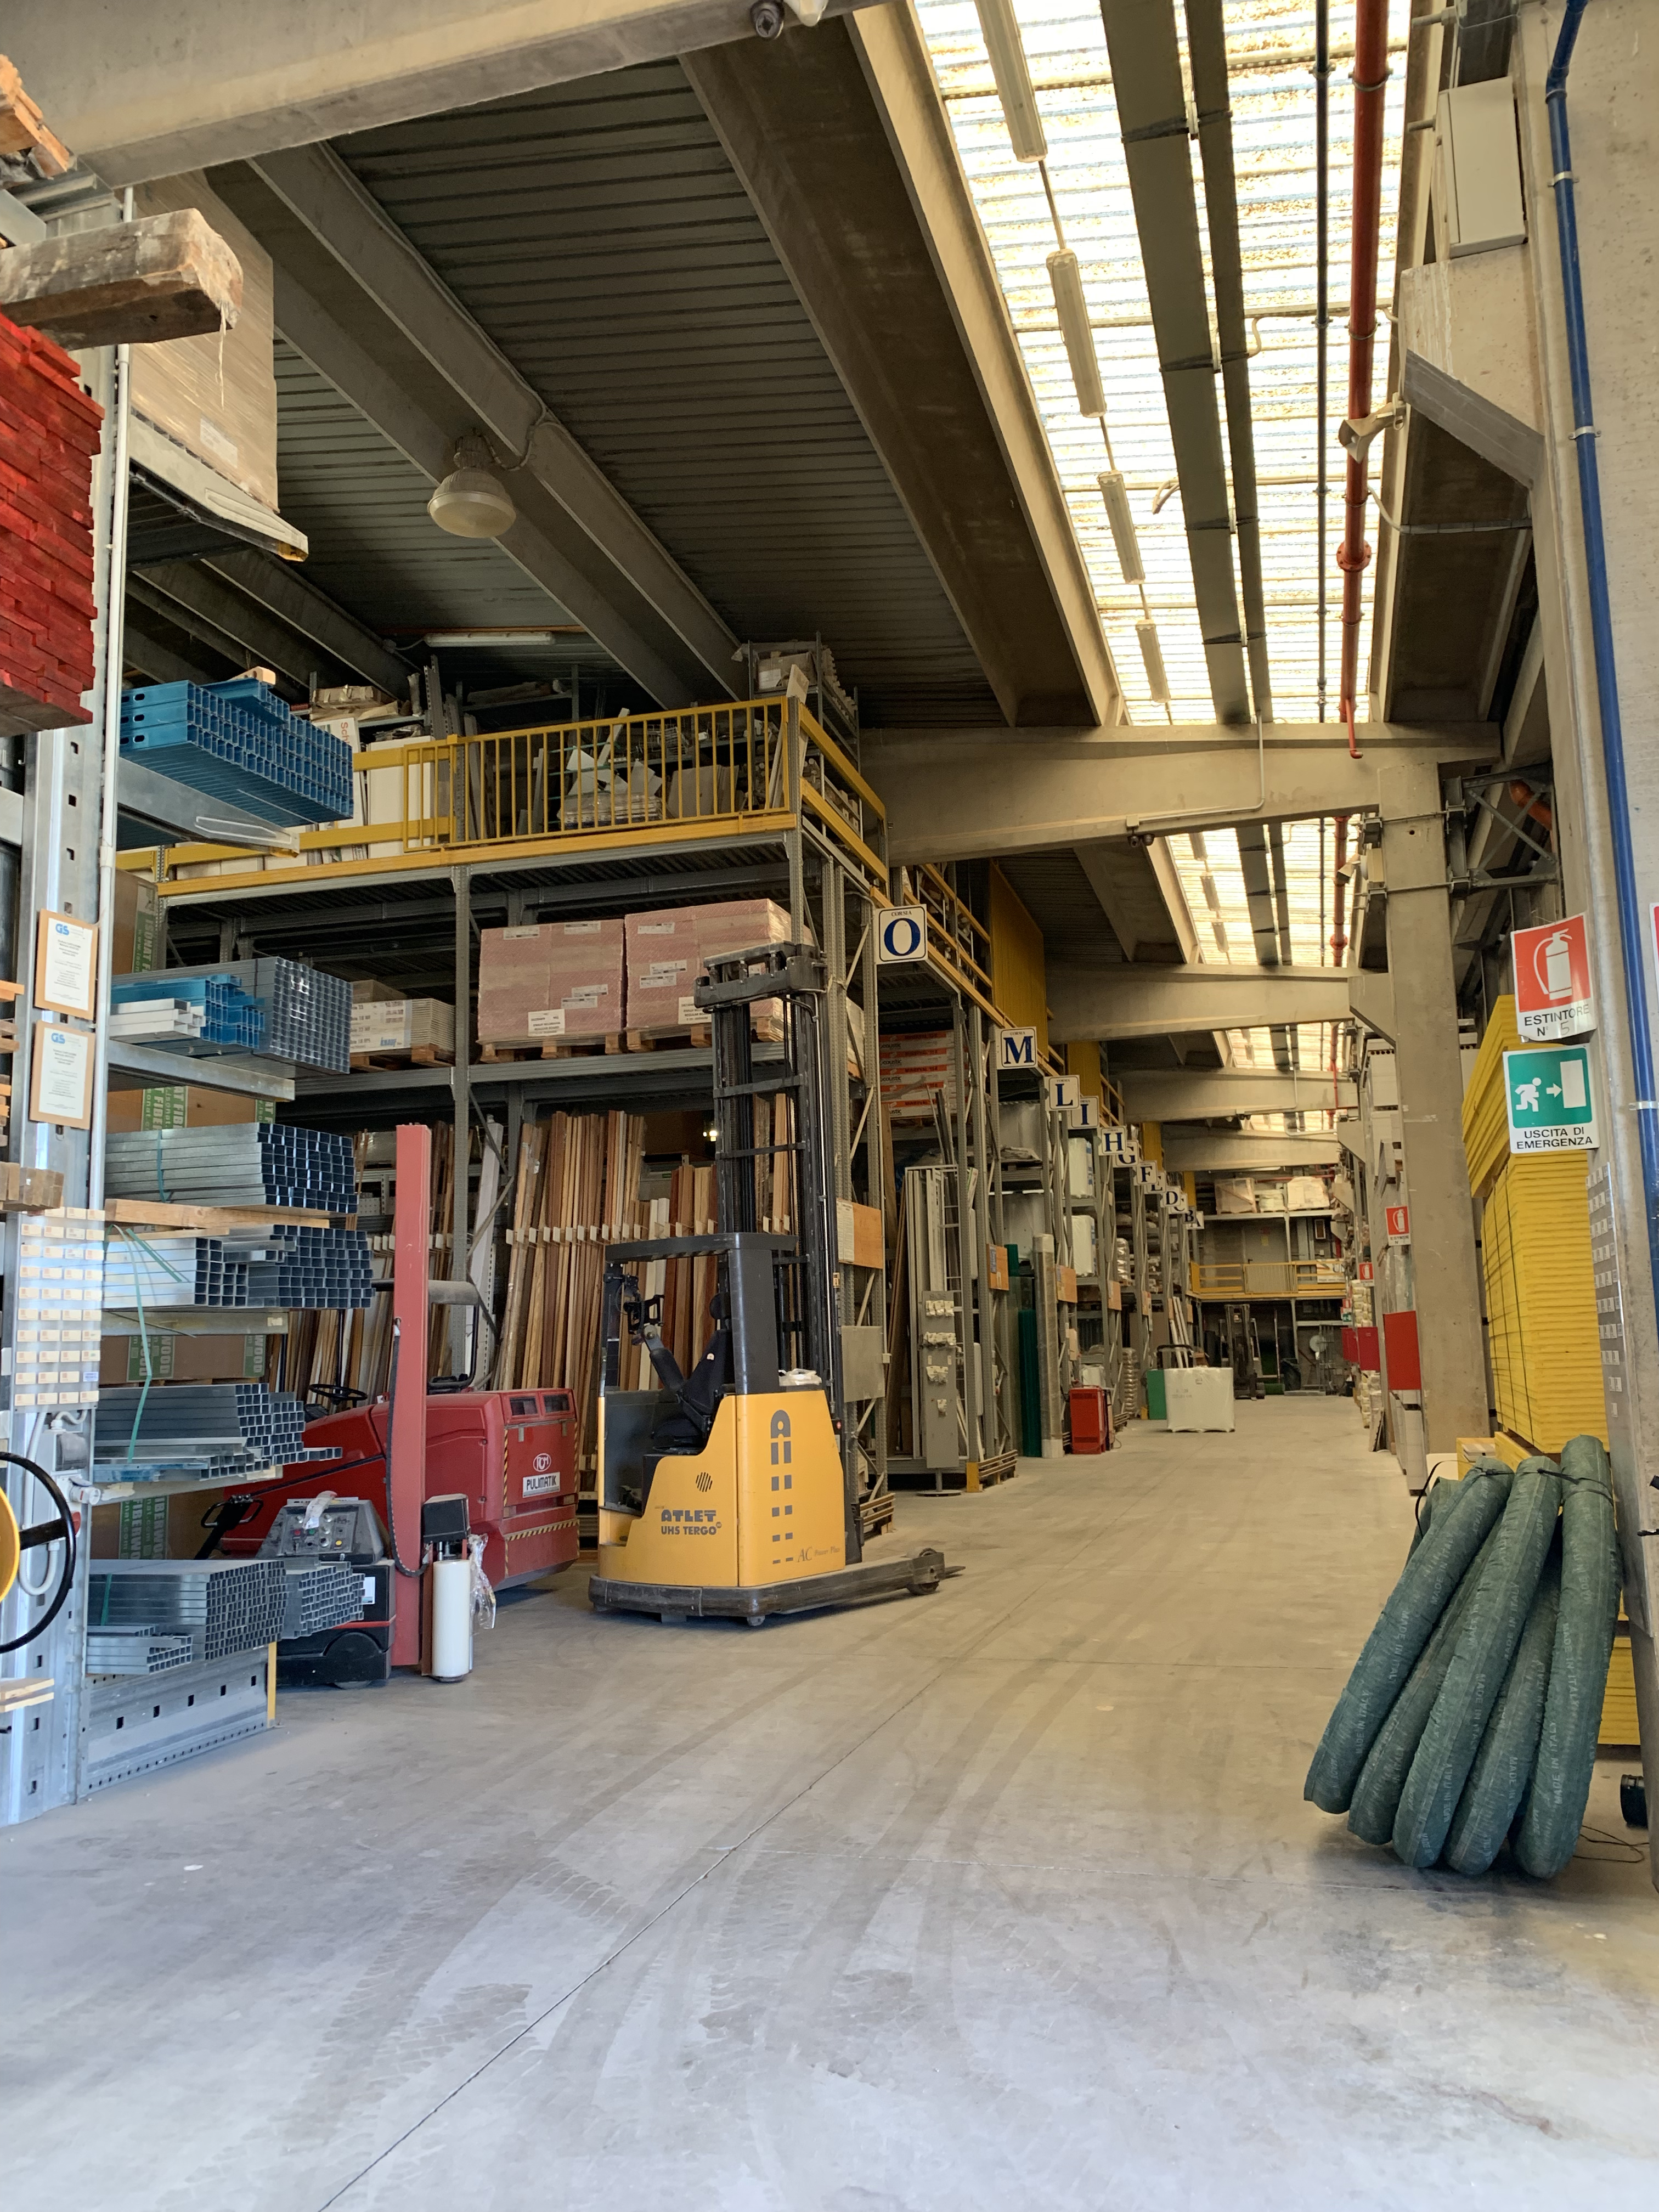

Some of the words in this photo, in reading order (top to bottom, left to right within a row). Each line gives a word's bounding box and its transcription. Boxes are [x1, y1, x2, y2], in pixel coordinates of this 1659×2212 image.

[884, 918, 921, 956] O
[1524, 1004, 1590, 1026] ESTINTORE
[1003, 1036, 1034, 1064] M
[1055, 1084, 1074, 1107] L
[1080, 1104, 1090, 1125] I
[1524, 1128, 1568, 1139] USCITA
[1573, 1126, 1584, 1135] DI
[1104, 1132, 1124, 1152] H
[1516, 1136, 1593, 1149] EMERGENZA
[1140, 1166, 1153, 1183] F
[1166, 1190, 1178, 1205] D
[1184, 1209, 1194, 1223] B
[527, 1475, 557, 1491] PULIMATIK
[661, 1509, 716, 1522] ATLET
[661, 1526, 680, 1535] UHS
[682, 1526, 717, 1536] TERGO
[1510, 1582, 1520, 1612] ITALY
[1398, 1610, 1409, 1640] MADE
[1508, 1616, 1516, 1628] IN
[1562, 1622, 1573, 1654] MADE
[1394, 1644, 1404, 1656] IN
[1566, 1657, 1576, 1669] IN
[1475, 1674, 1486, 1704] MADE
[1567, 1674, 1579, 1708] ITALY
[1358, 1690, 1370, 1718] ITALY
[1475, 1708, 1481, 1720] IN
[1358, 1720, 1367, 1730] IN
[1549, 1720, 1558, 1752] ITALY
[1508, 1756, 1519, 1786] MADE
[1551, 1757, 1560, 1771] IN
[1508, 1789, 1516, 1800] IN
[1551, 1773, 1564, 1805] MADE
